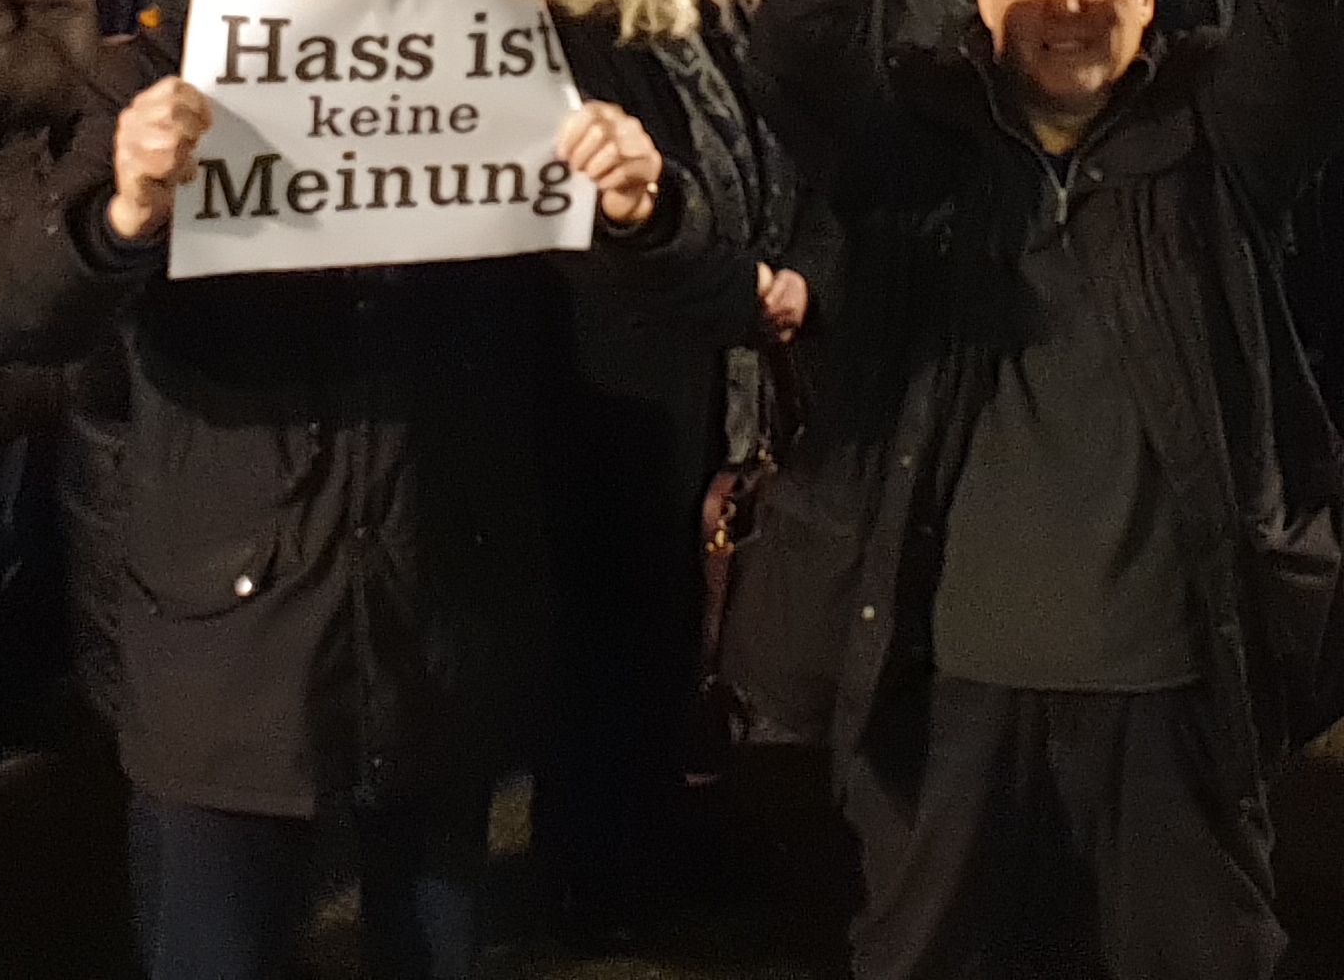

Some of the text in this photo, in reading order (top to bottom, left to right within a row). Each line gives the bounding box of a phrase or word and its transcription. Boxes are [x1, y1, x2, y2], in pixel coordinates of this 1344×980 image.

[215, 11, 563, 85] Hass ist
[306, 94, 480, 139] keine
[194, 151, 573, 220] Meinung
